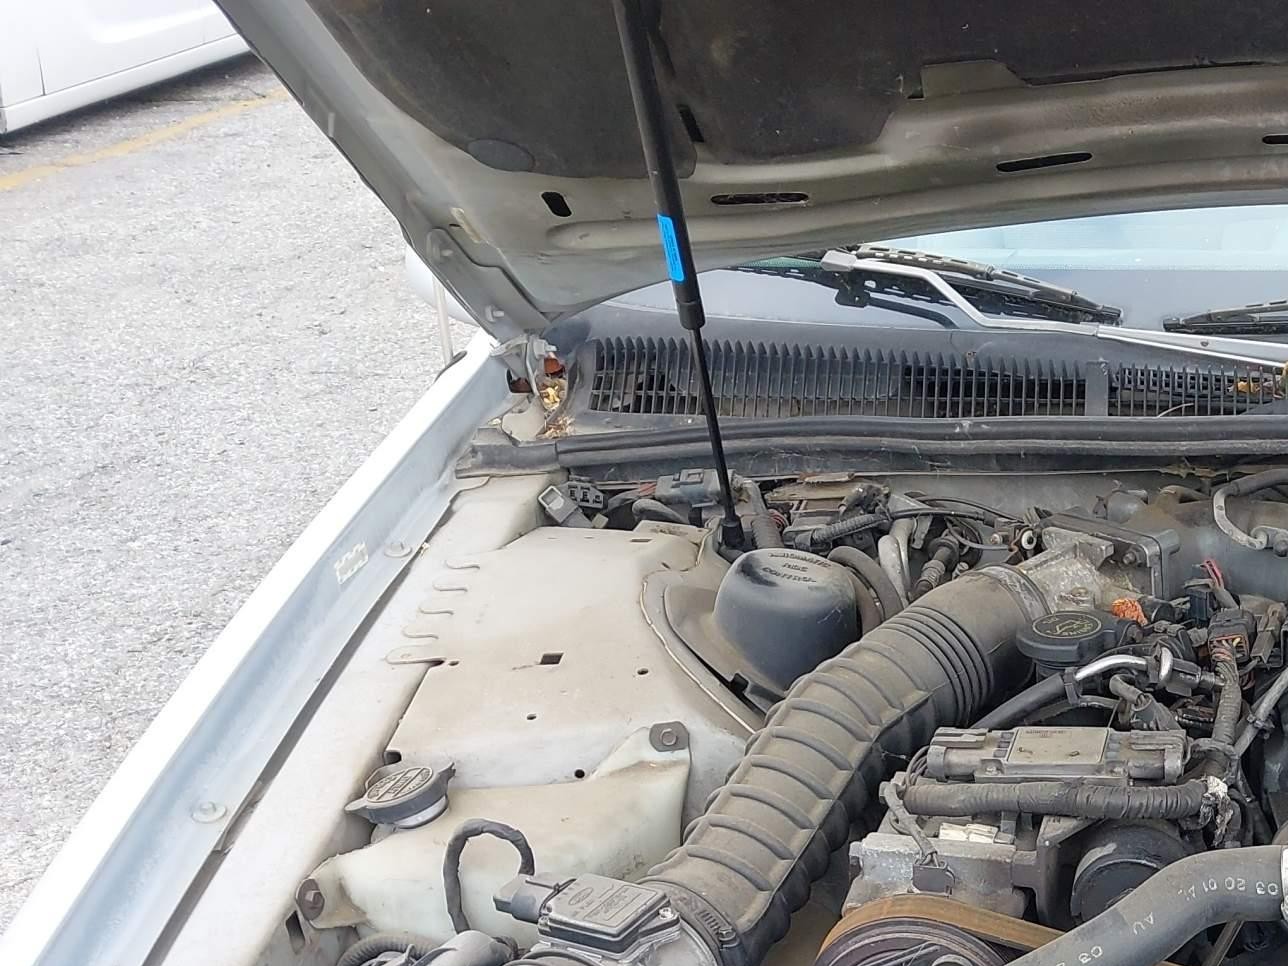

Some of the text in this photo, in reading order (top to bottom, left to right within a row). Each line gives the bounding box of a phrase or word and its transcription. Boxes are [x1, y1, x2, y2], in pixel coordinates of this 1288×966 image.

[1202, 878, 1218, 893] 01
[1224, 877, 1247, 892] 20
[1256, 881, 1279, 896] 03
[1077, 944, 1104, 965] 03
